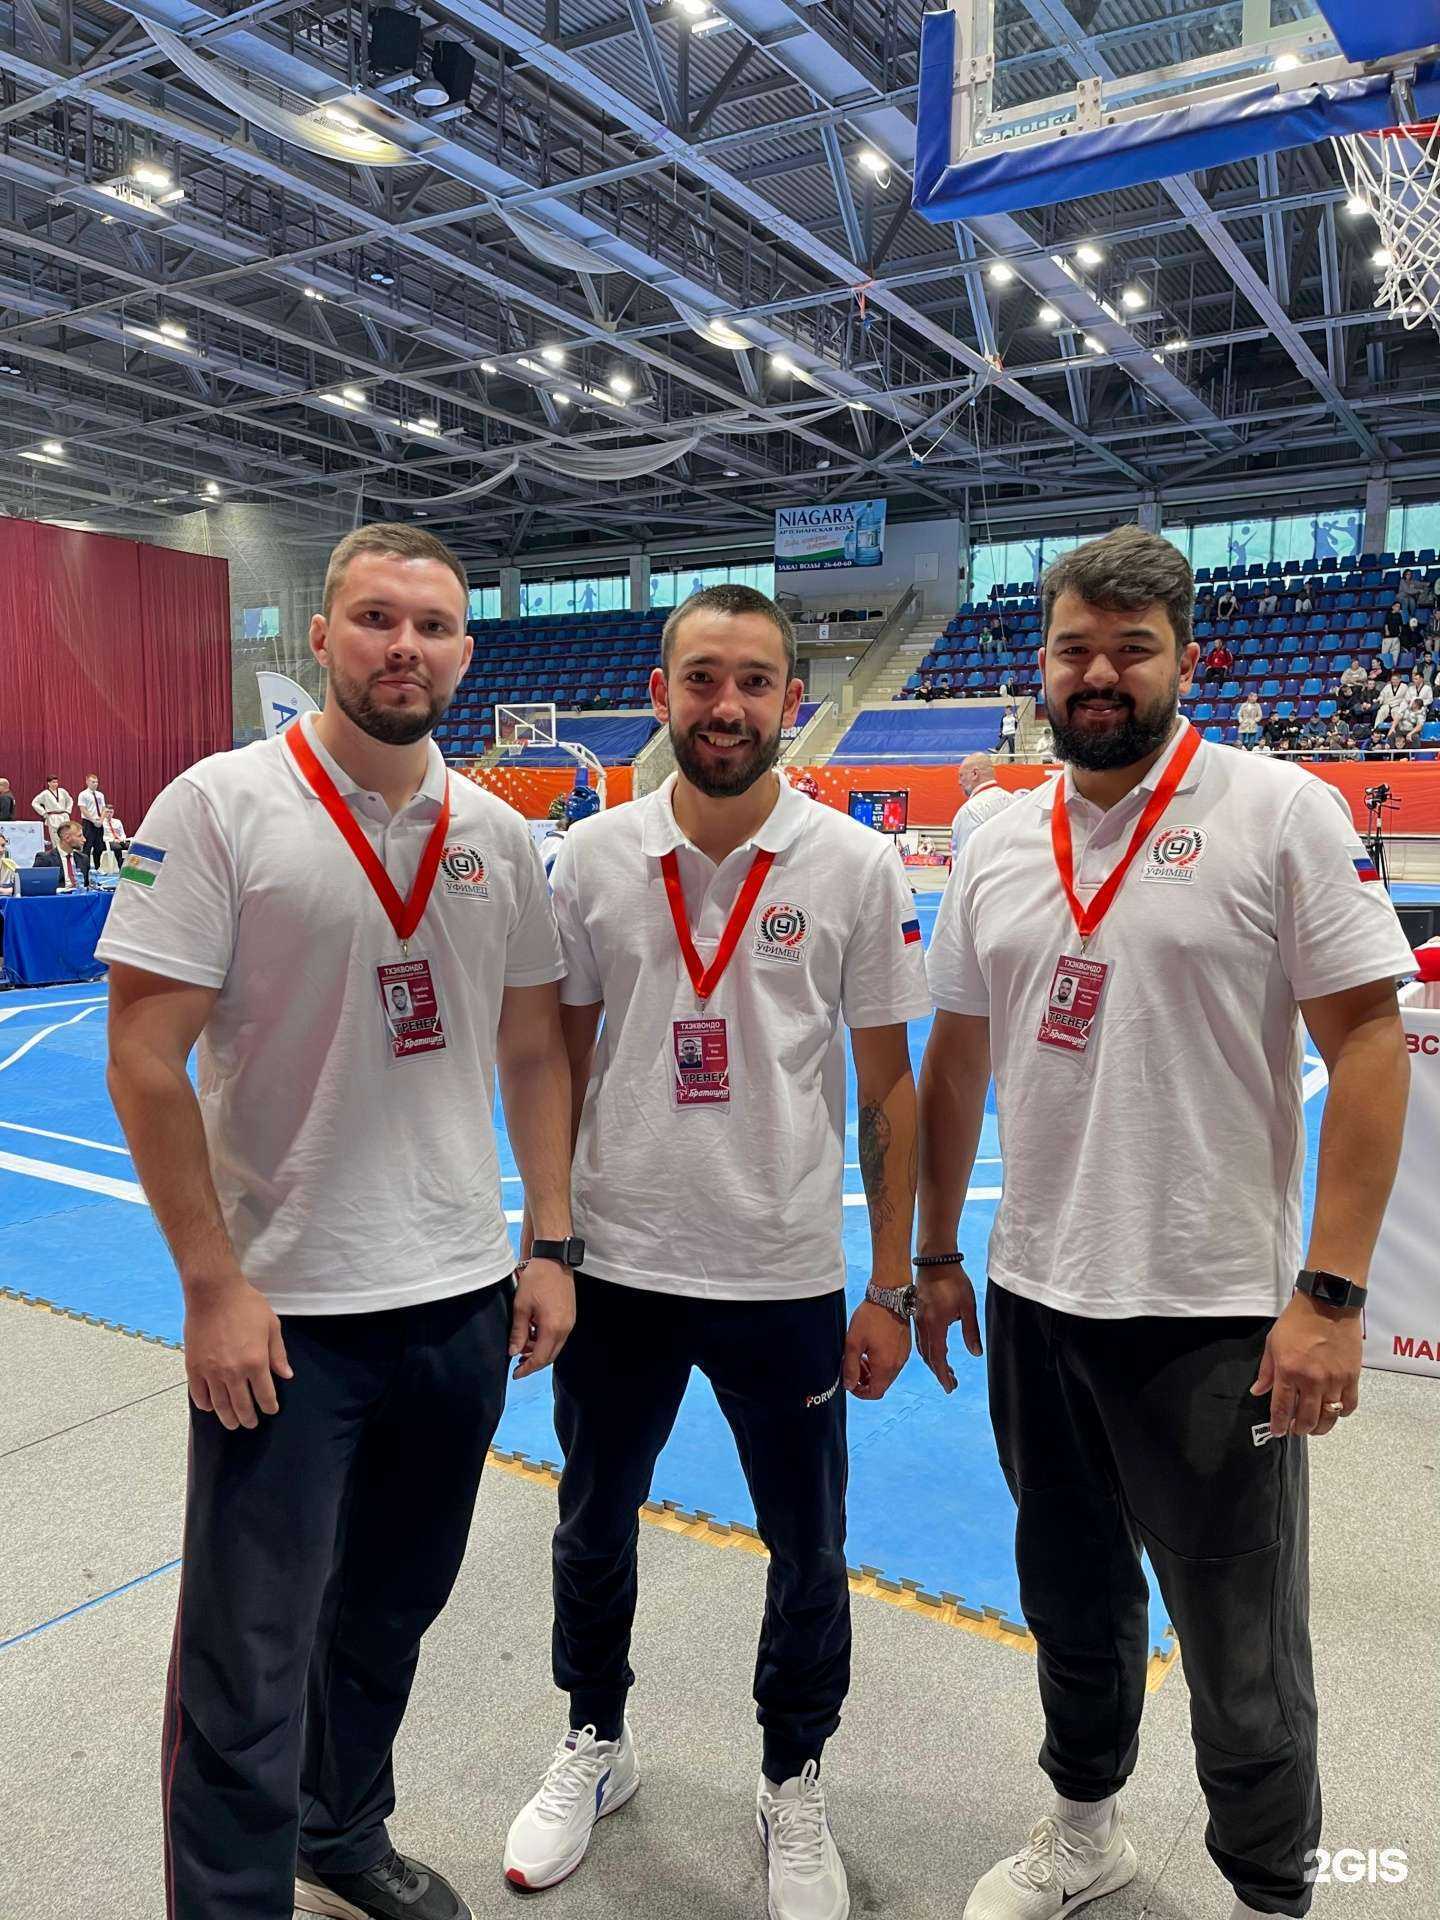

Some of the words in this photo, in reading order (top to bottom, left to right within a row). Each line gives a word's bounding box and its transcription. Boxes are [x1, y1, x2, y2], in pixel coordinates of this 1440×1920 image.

[779, 507, 854, 527] NIAGARA
[1146, 867, 1193, 878] УФИМЕЦ
[446, 882, 488, 895] УФИМЕЦ
[756, 943, 800, 959] УФИМЕЦ
[383, 963, 424, 975] ТХЭКВОНДО
[1063, 959, 1102, 974] ТХЭКВОНДО
[393, 1017, 437, 1034] ТРЕНЕР
[680, 1021, 720, 1029] ТХЭКВОНДО
[1048, 1011, 1089, 1030] ТРЕНЕР
[681, 1072, 725, 1084] ТРЕНЕР
